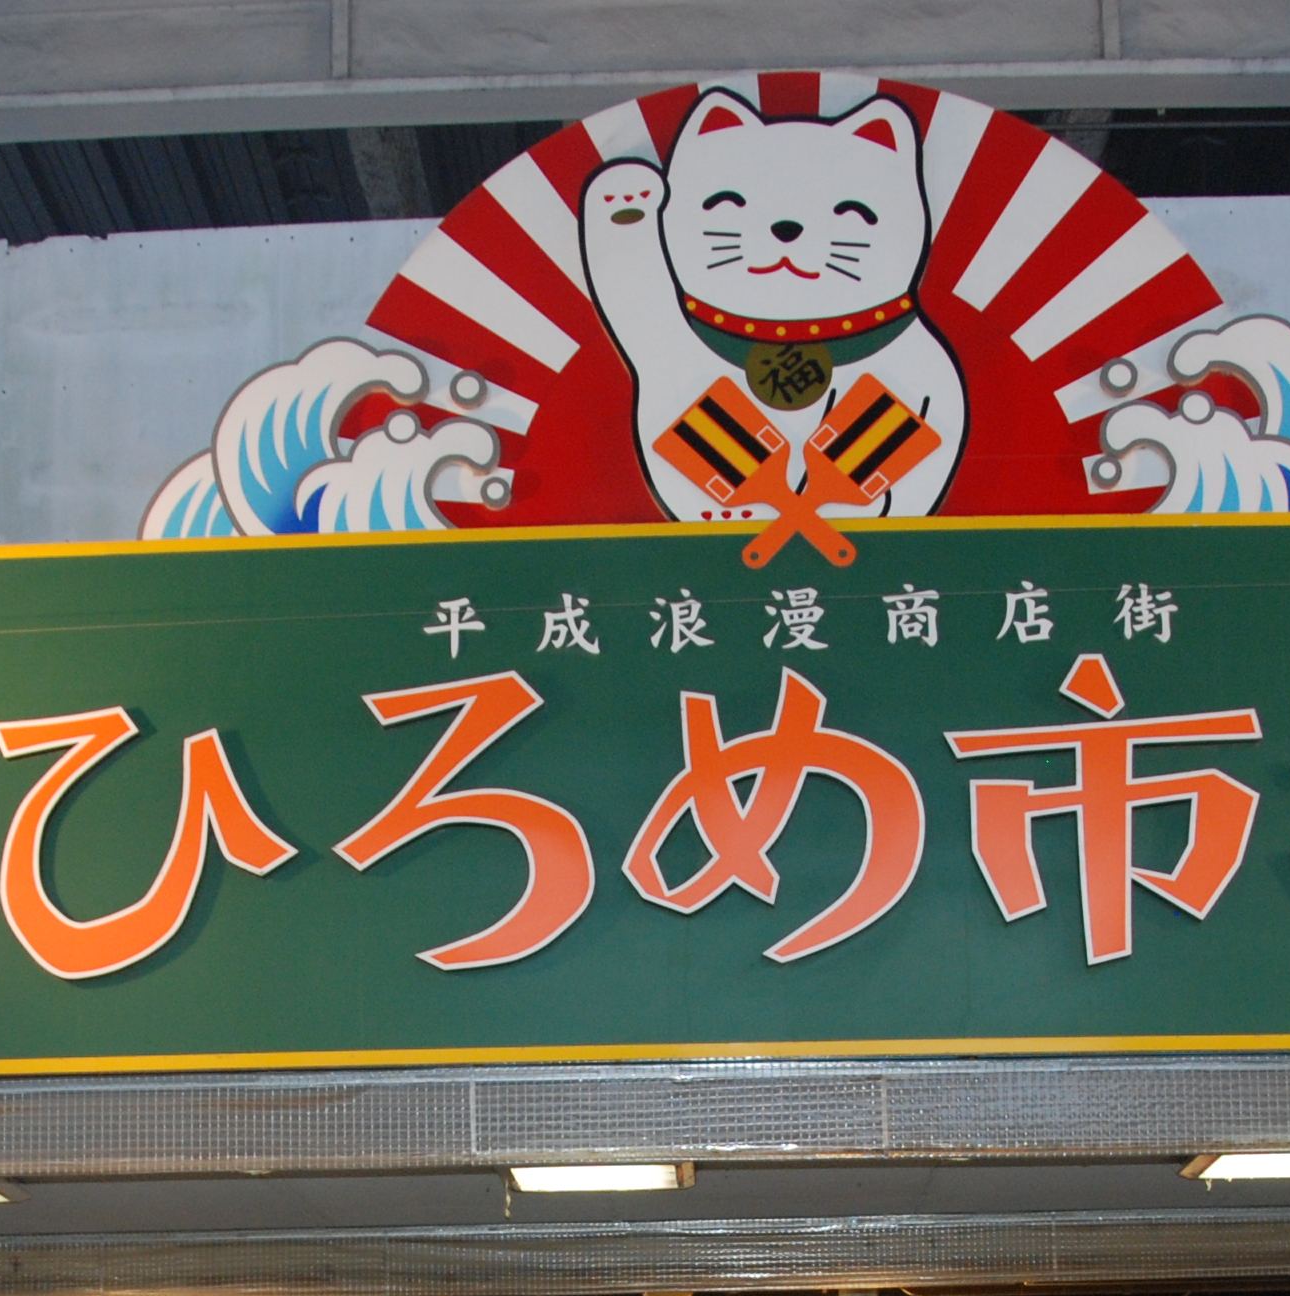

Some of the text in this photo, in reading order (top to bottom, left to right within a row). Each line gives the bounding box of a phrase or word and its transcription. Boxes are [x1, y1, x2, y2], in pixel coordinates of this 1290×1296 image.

[423, 582, 1179, 659] 平成浪漫商店街
